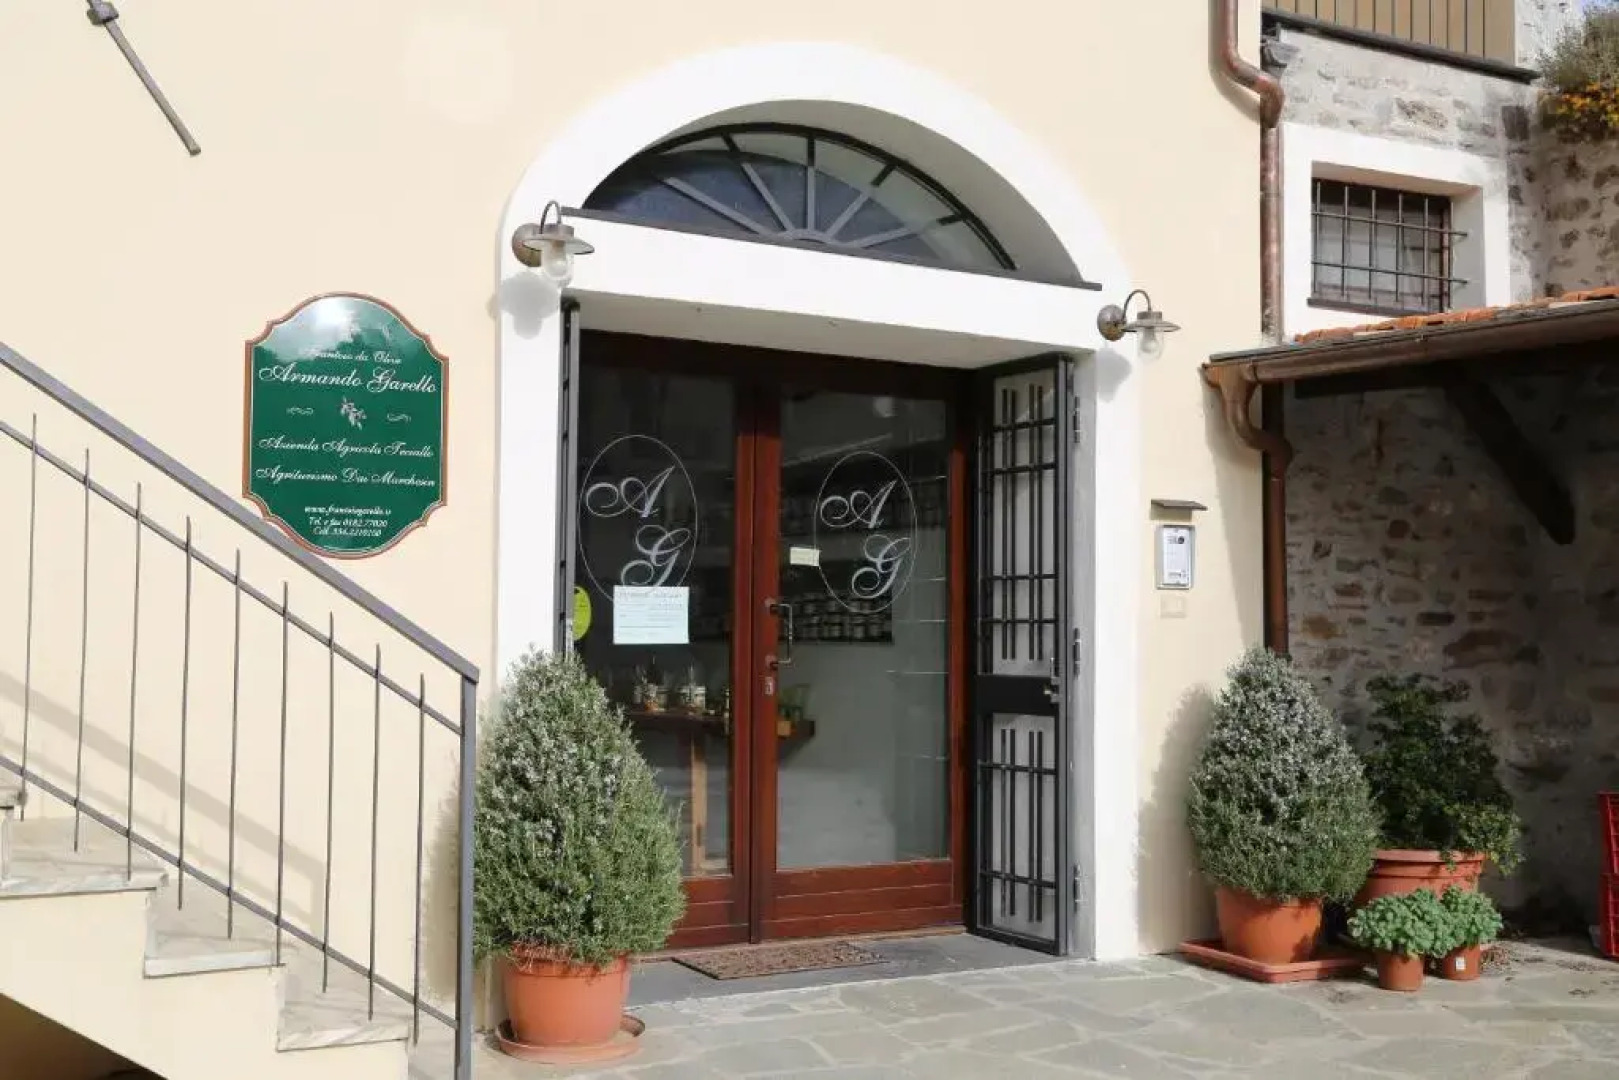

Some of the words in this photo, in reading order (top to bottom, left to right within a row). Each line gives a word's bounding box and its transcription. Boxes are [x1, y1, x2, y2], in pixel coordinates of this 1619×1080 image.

[258, 361, 362, 387] Armando
[366, 366, 437, 393] Garello
[258, 434, 320, 452] Azienda
[322, 437, 382, 457] Agricola
[255, 464, 338, 484] Agriturismo
[586, 465, 676, 518] A
[819, 479, 898, 529] A
[621, 524, 692, 591] G
[851, 534, 912, 599] G
